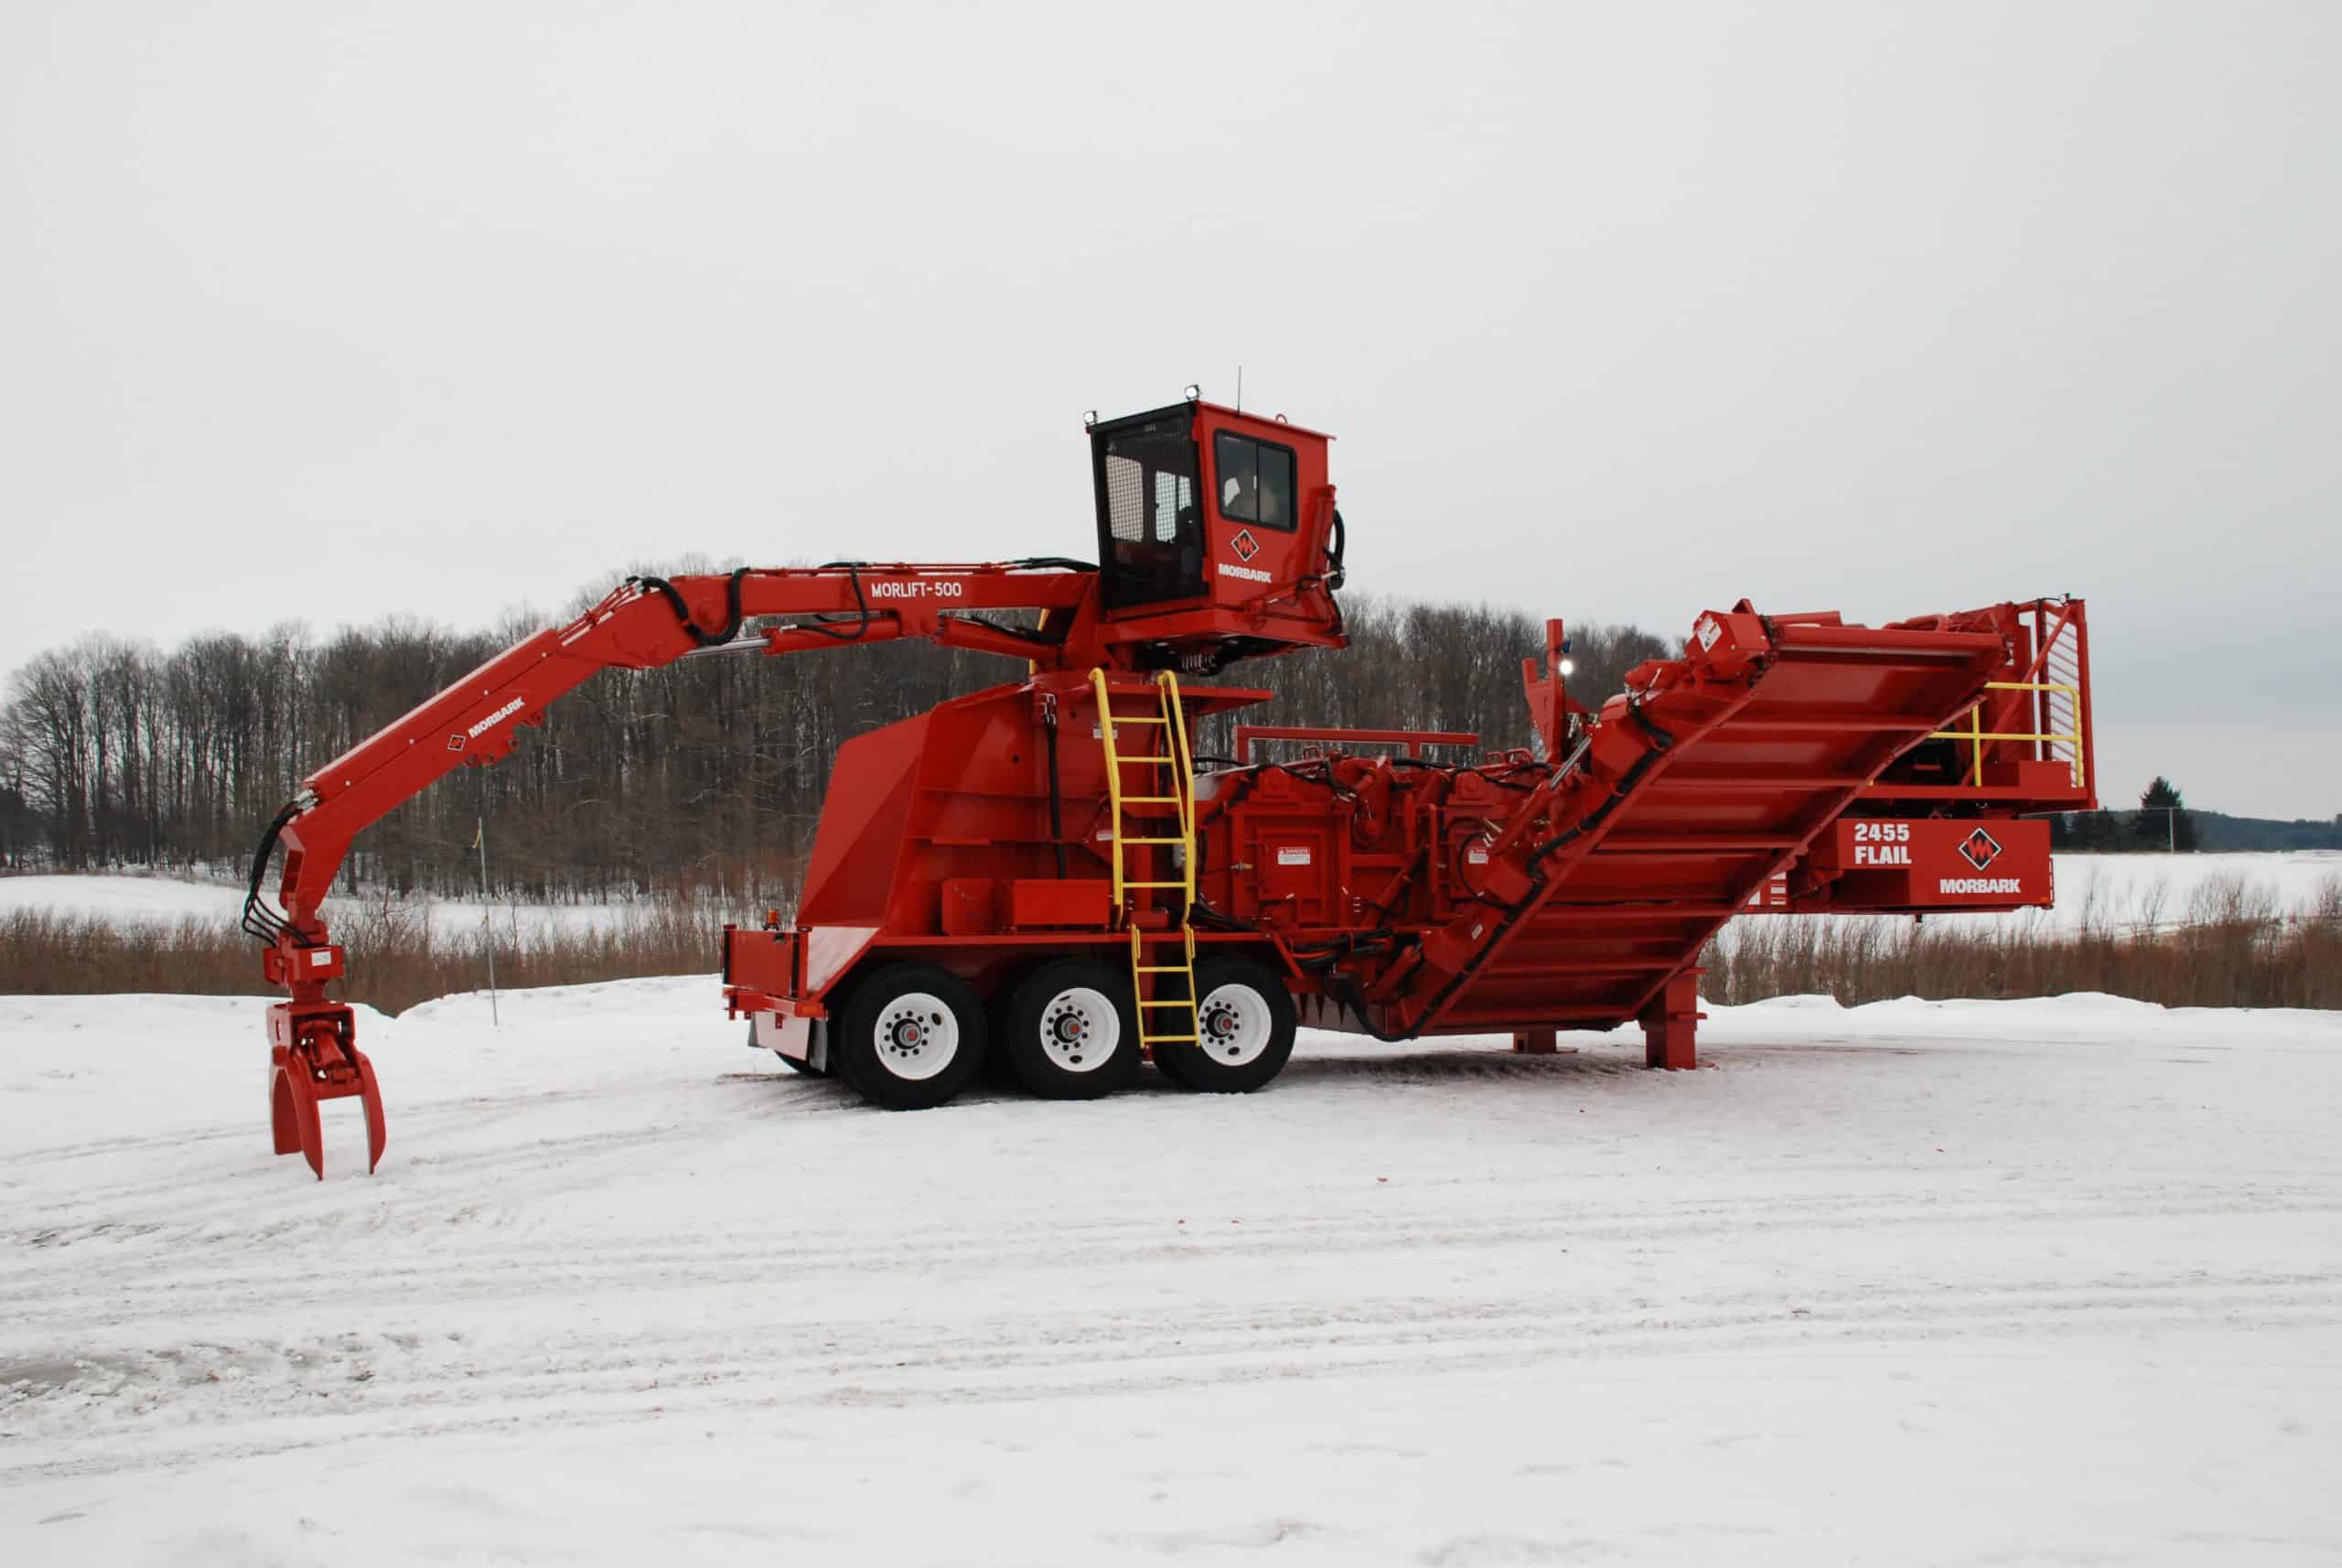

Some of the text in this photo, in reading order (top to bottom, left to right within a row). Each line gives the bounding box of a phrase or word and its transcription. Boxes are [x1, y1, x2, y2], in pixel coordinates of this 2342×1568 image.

[1217, 562, 1273, 585] MORBARK
[870, 581, 963, 598] MORLIFT-500
[467, 695, 526, 739] MORBARK
[1853, 822, 1911, 842] 2455
[1853, 845, 1913, 865] FLAIL
[1939, 878, 2021, 894] MORBARK
